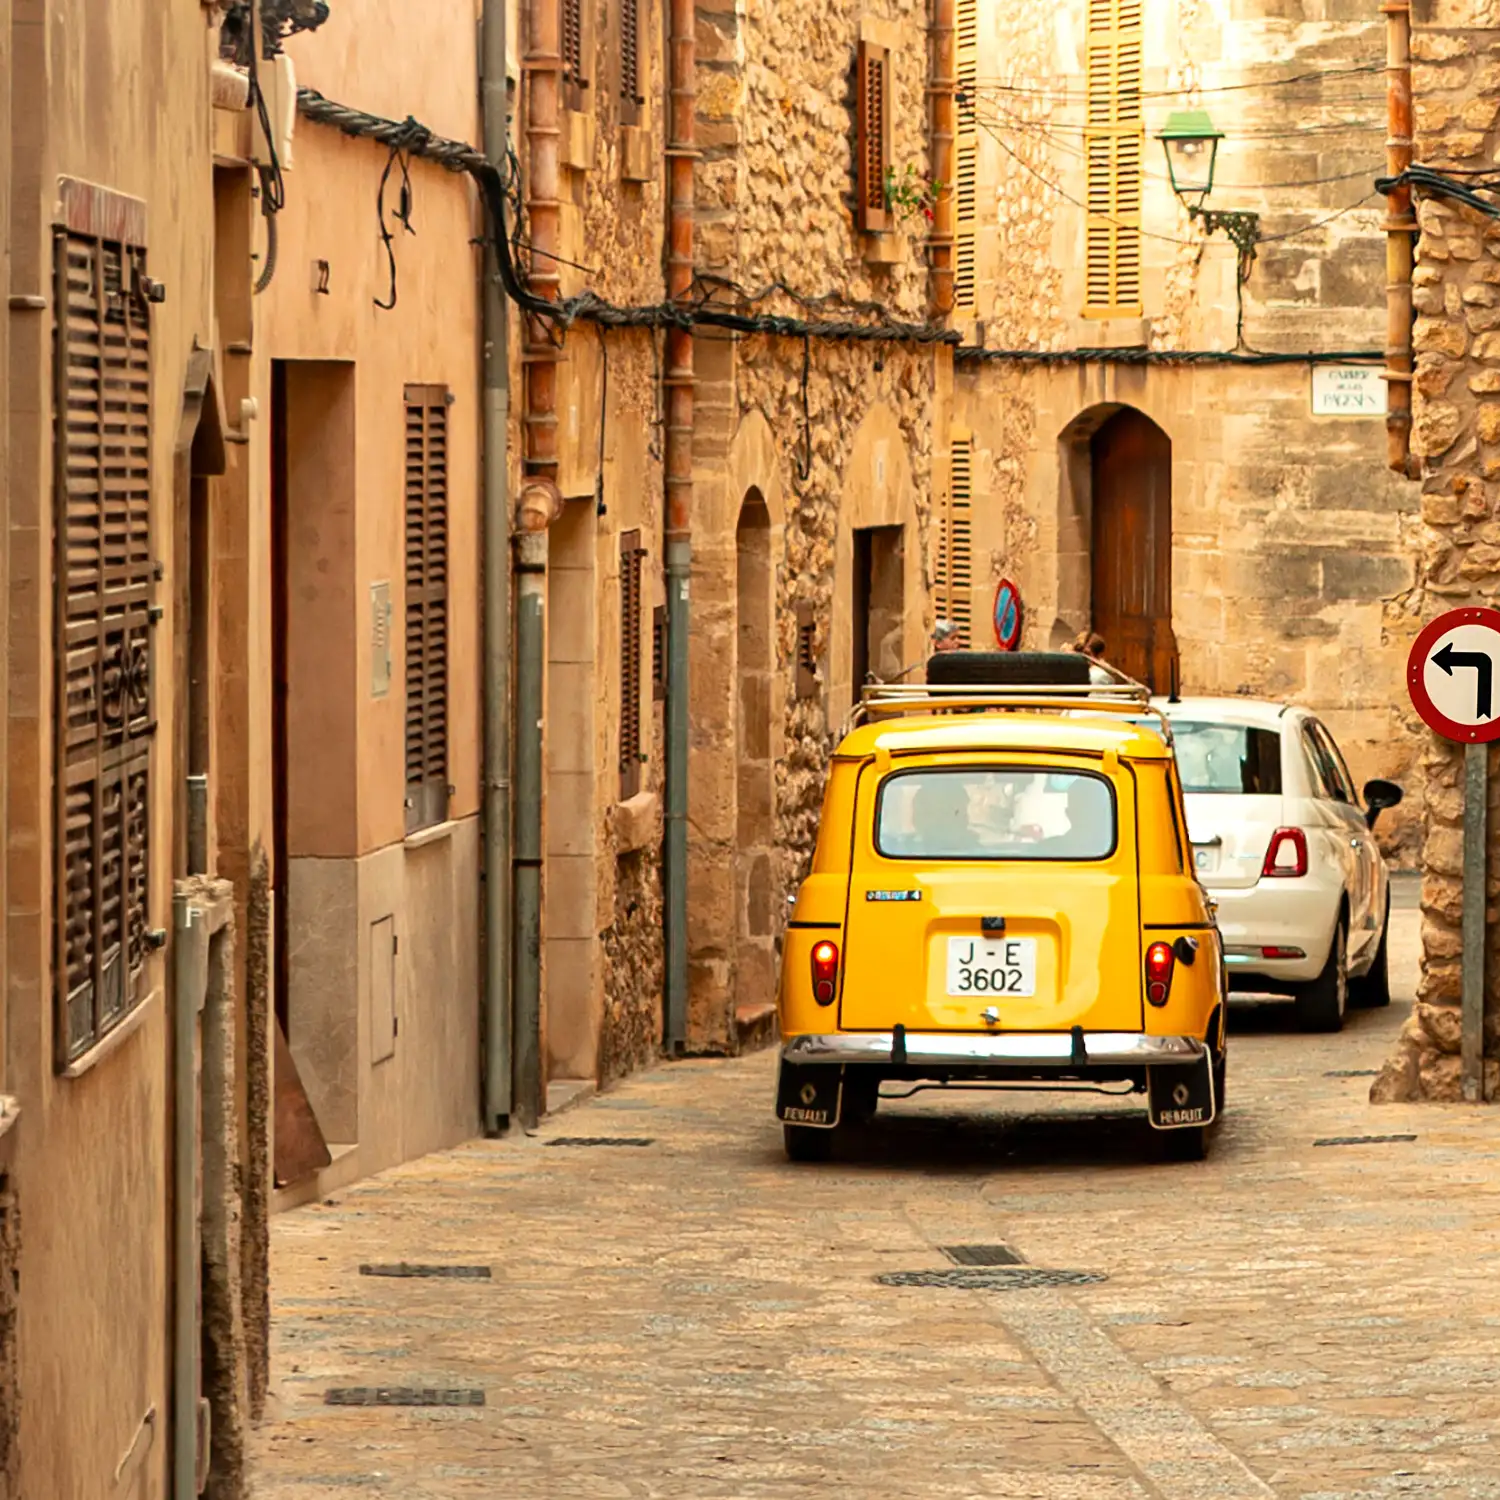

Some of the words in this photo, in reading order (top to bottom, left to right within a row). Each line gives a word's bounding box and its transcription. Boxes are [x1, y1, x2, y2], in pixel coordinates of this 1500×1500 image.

[958, 942, 974, 965] J
[1006, 942, 1021, 966] E
[958, 968, 1022, 992] 3602
